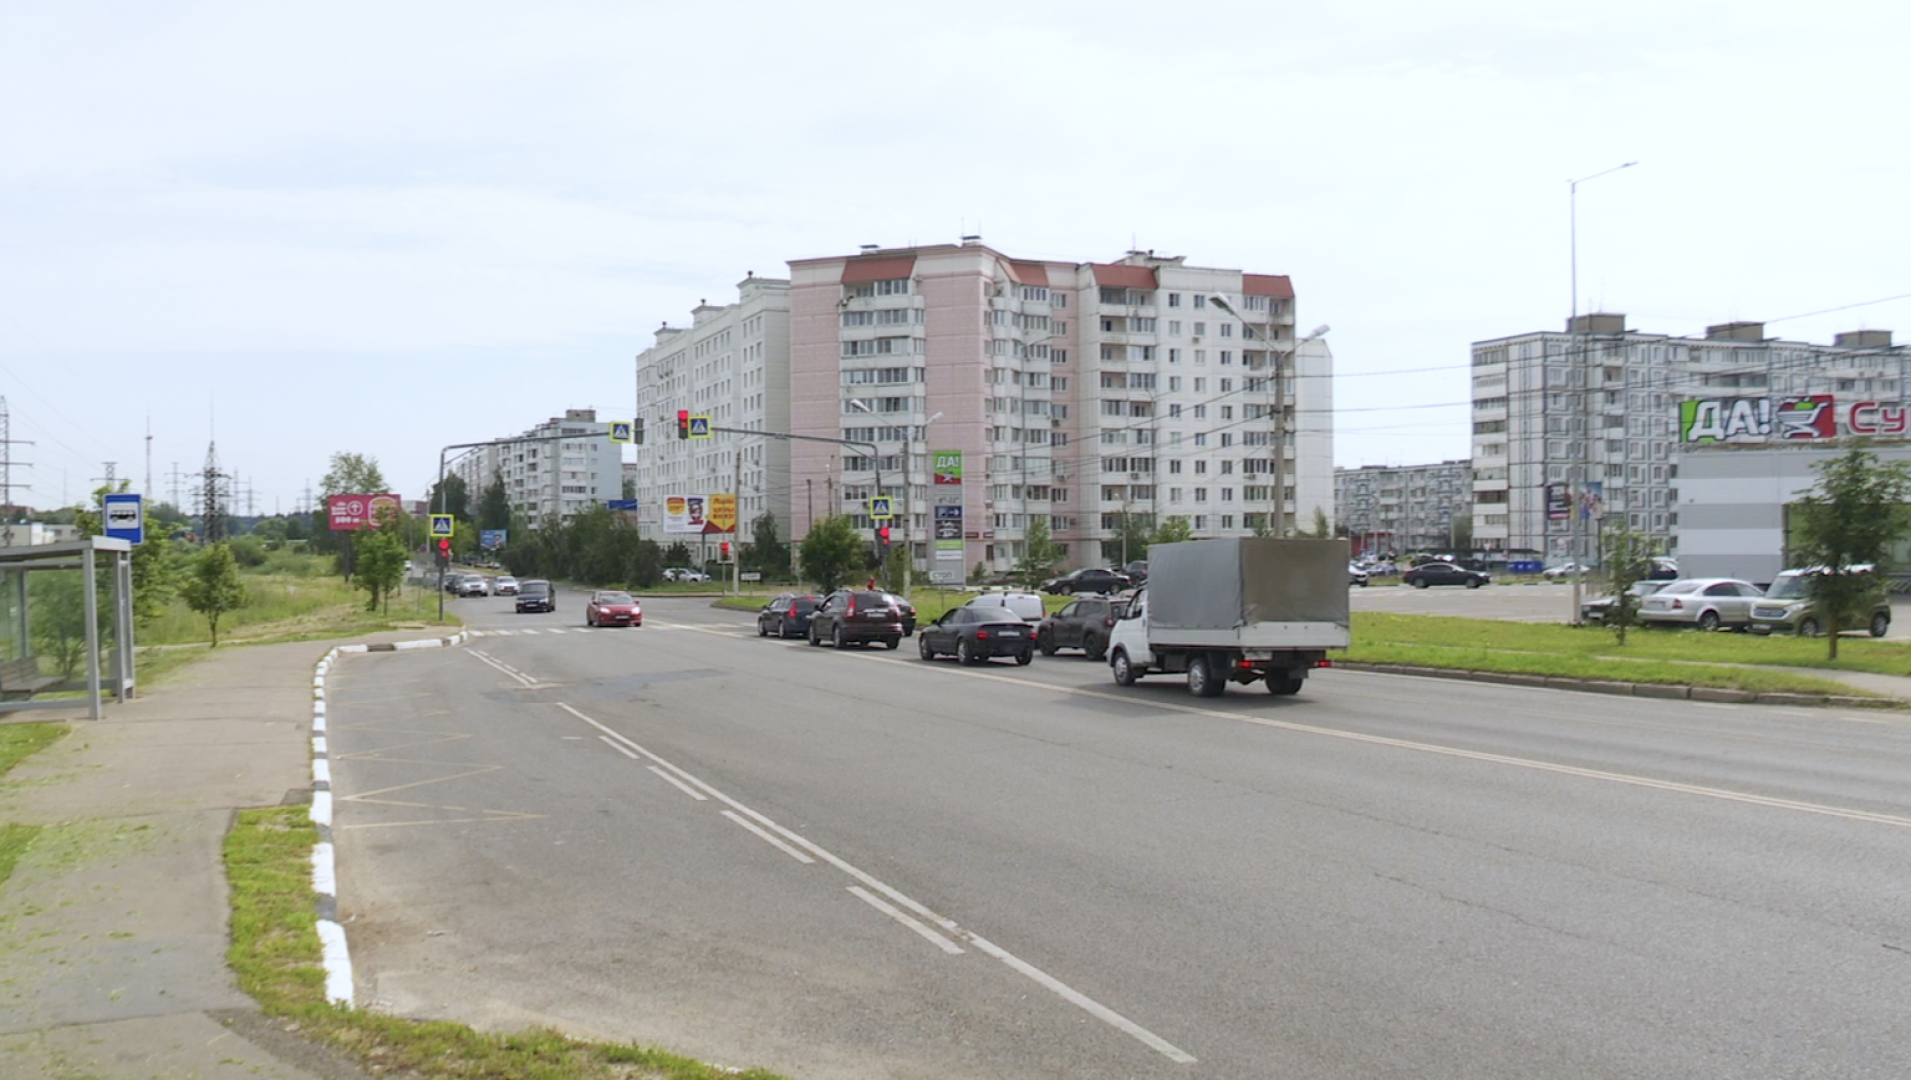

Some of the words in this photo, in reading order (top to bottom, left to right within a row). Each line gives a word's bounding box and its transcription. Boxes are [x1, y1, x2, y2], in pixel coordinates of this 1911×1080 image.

[1687, 399, 1770, 441] ДА!
[1849, 401, 1911, 434] Су
[936, 455, 959, 468] ДА!
[932, 571, 953, 579] СТОП
